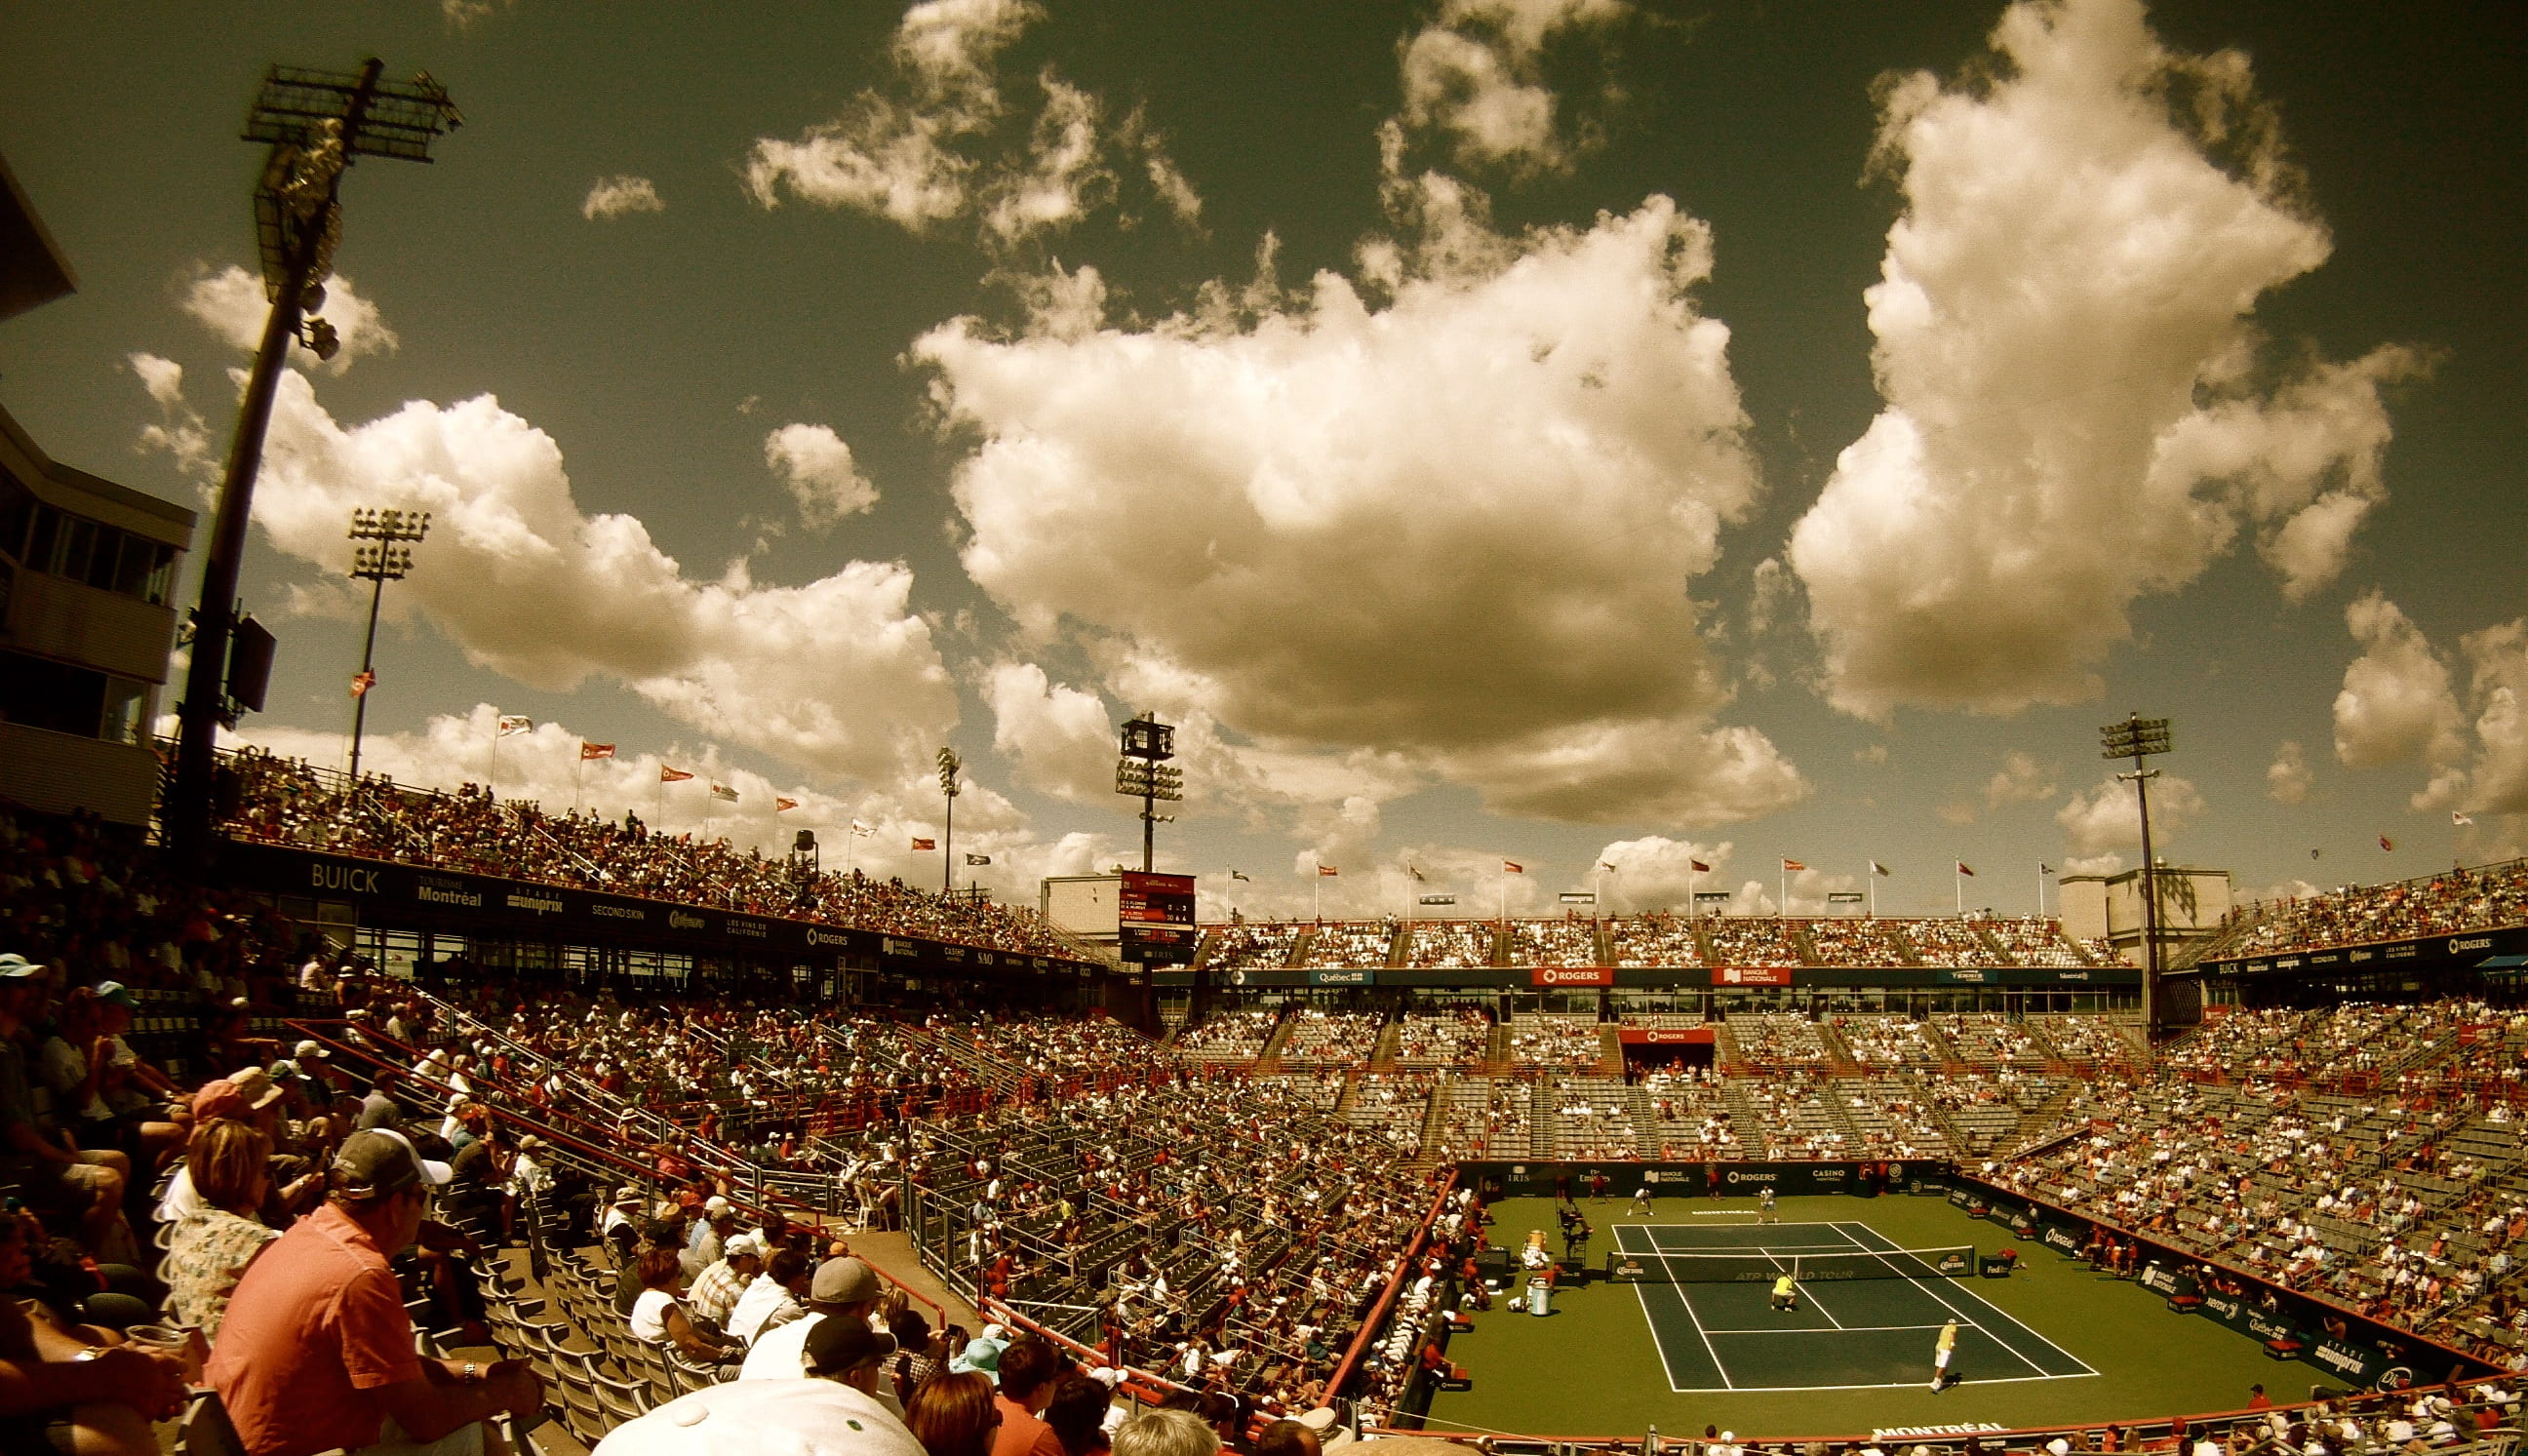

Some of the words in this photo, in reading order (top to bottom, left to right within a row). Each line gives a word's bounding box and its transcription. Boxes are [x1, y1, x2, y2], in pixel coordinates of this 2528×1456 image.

[311, 864, 381, 894] BUICK
[417, 885, 482, 907] Montréal
[519, 895, 564, 916] uniprix
[592, 904, 625, 919] SECOND
[626, 909, 645, 921] SKIN
[818, 932, 849, 947] ROGERS
[2459, 938, 2492, 950] ROGERS
[977, 952, 994, 966] SAQ
[1154, 951, 1174, 960] IRIS
[1320, 972, 1351, 983] Québec
[1558, 971, 1600, 981] ROGERS
[1658, 1032, 1684, 1041] ROGERS
[1508, 1173, 1530, 1183] IRIS
[1740, 1172, 1777, 1182] ROGERS
[1812, 1169, 1845, 1178] CASINO
[2053, 1233, 2076, 1249] ROGERS
[1616, 1266, 1645, 1277] Corona
[1735, 1272, 1761, 1281] ATP
[1819, 1269, 1855, 1280] TOUR
[2249, 1318, 2274, 1337] Québec
[2326, 1339, 2364, 1361] STADE
[2325, 1348, 2365, 1375] uniprix
[1872, 1421, 2011, 1436] MONTRÉAL
